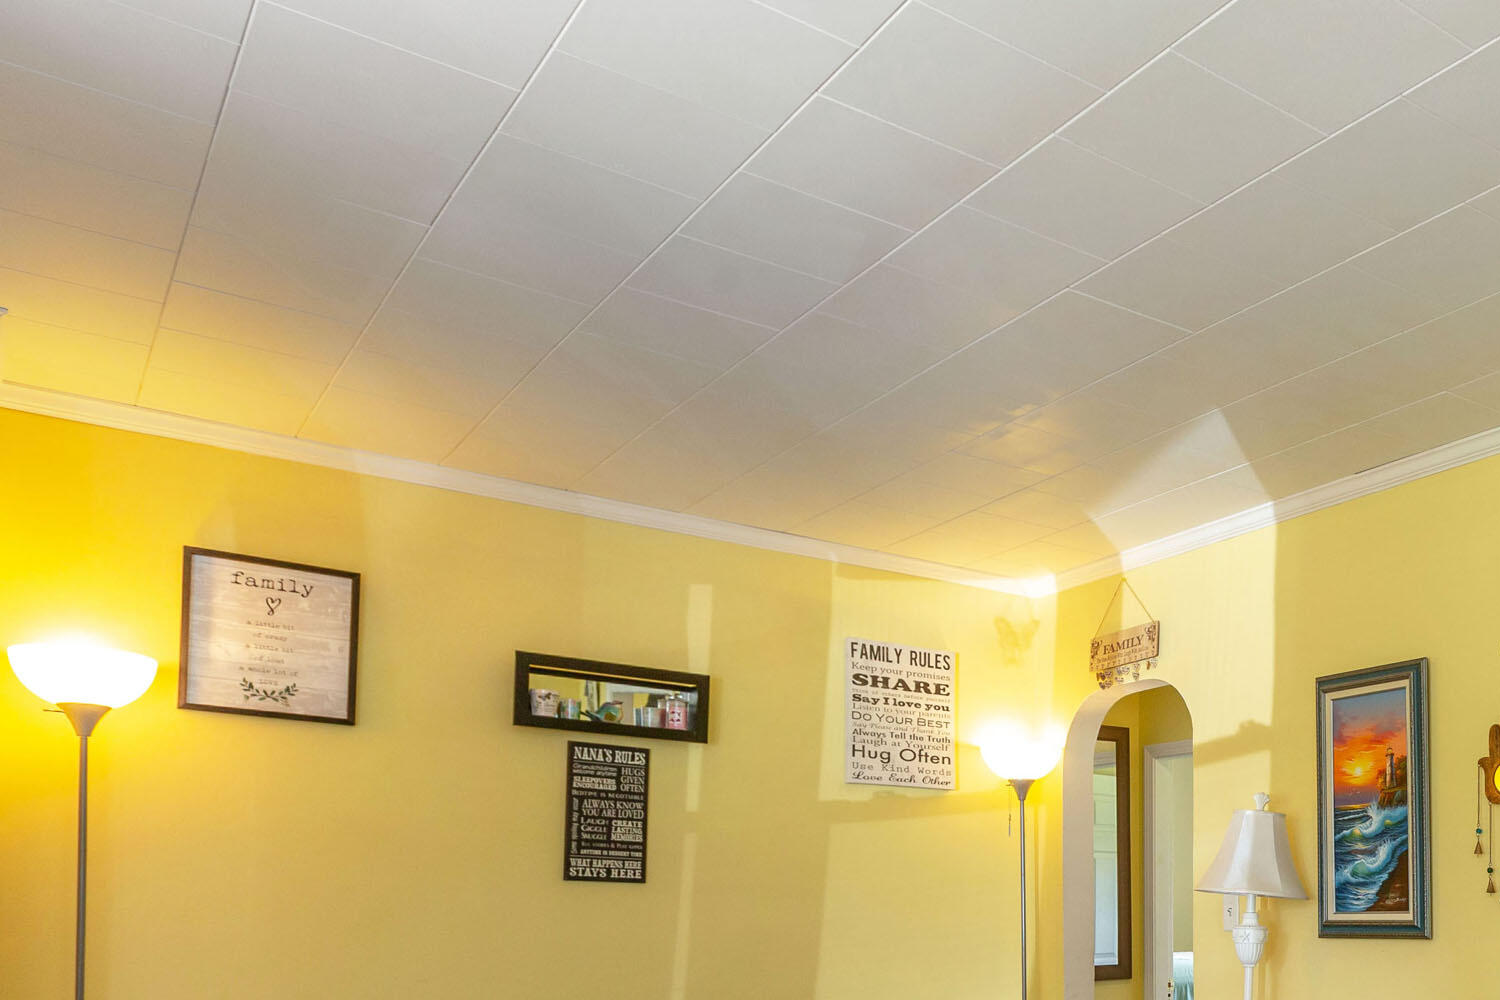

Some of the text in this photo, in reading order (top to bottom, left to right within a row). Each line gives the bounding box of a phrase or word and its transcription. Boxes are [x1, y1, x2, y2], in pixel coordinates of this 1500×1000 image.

[231, 571, 314, 597] family
[1103, 634, 1144, 655] FAMILY
[851, 642, 950, 670] FAMILY RULES
[852, 662, 950, 681] Keep your promises
[852, 673, 950, 696] SHARE
[852, 694, 880, 705] Say
[883, 697, 890, 705] I
[893, 698, 921, 708] love
[853, 703, 880, 711] Listen
[852, 729, 886, 738] Always
[853, 736, 887, 746] Laugh
[906, 741, 950, 751] Yourself
[574, 747, 645, 765] NANA'S RULES
[852, 744, 950, 765] Hug Often
[622, 767, 645, 776] HUGS
[852, 762, 951, 776] Use Kind Words
[621, 776, 644, 784] GIVEN
[853, 771, 950, 785] Love Each Other
[621, 784, 644, 792] OFTEN
[582, 799, 643, 809] ALWAYS KNOW
[602, 809, 616, 817] ARE
[618, 810, 644, 819] LOVED
[612, 820, 643, 828] CREATE
[611, 833, 642, 842] MEMORIES
[570, 858, 642, 869] WHAT HAPPENS HERE
[570, 867, 642, 879] STAYS HERE
